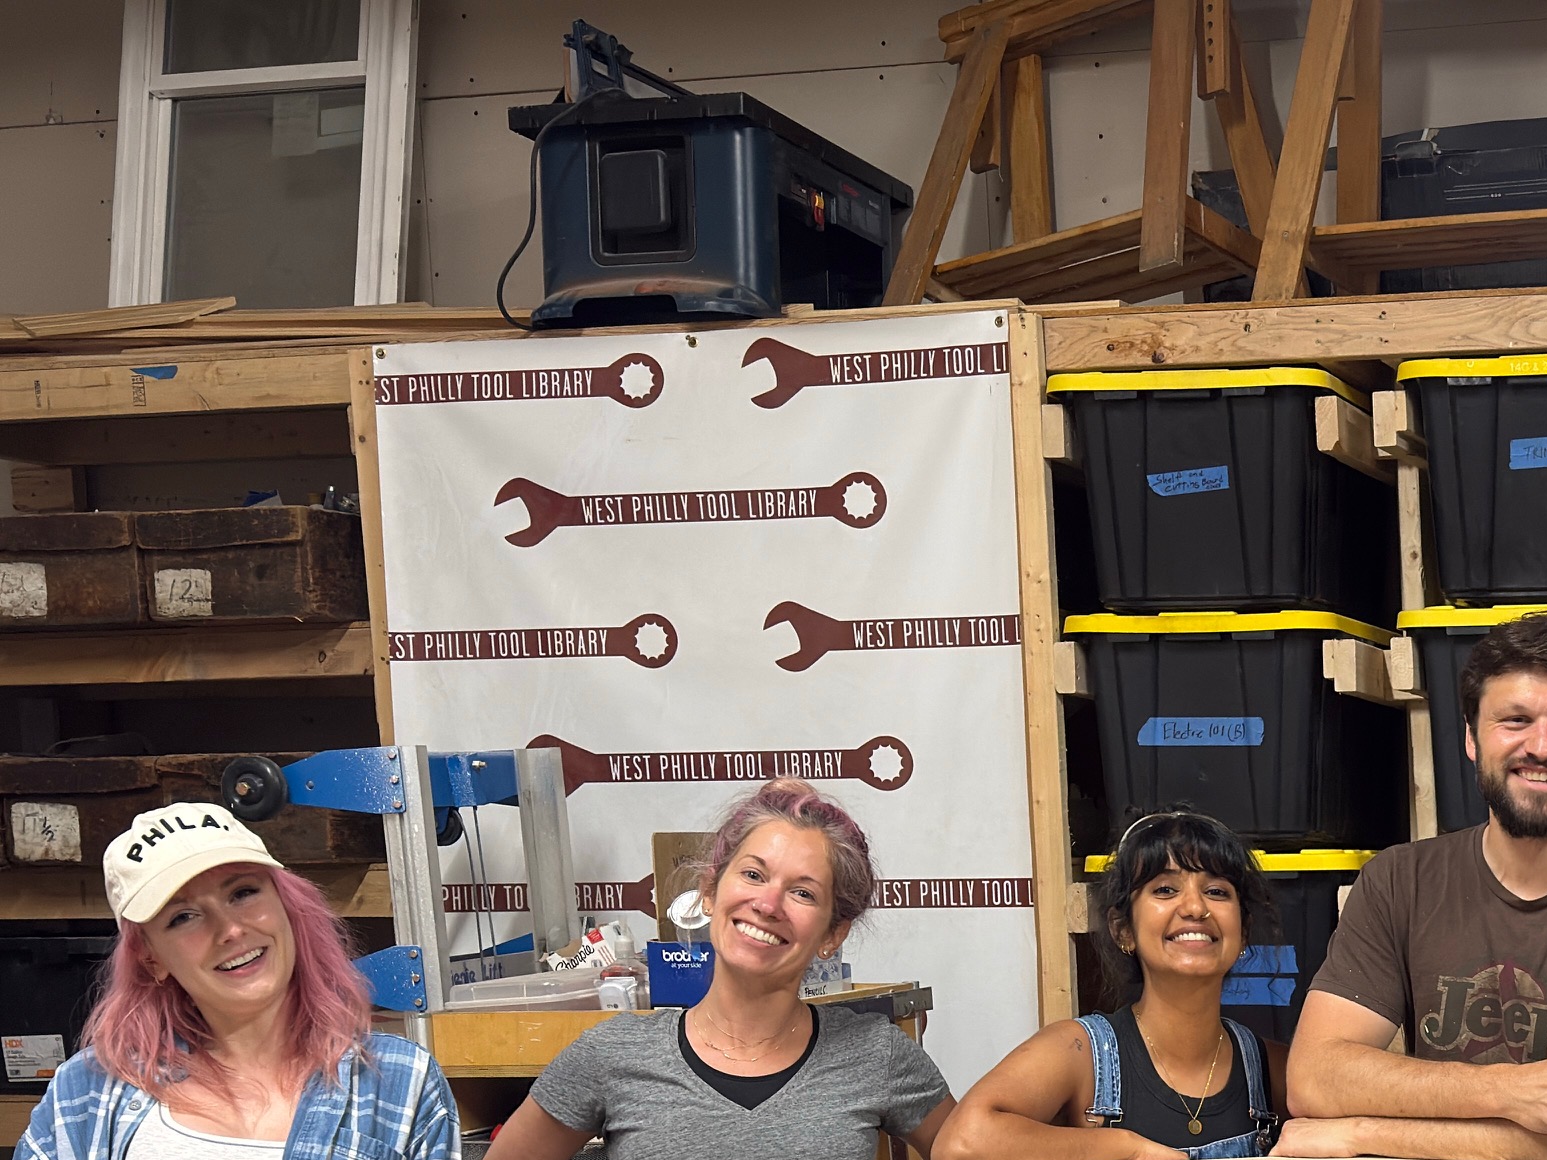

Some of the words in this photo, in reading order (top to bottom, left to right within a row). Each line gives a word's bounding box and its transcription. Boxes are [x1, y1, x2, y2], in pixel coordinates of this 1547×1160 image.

[829, 354, 871, 383] WEST
[880, 350, 935, 380] PHILLY
[943, 346, 985, 375] TOOL
[408, 375, 463, 402] PHILLY
[471, 373, 513, 399] TOOL
[522, 369, 592, 397] LIBRARY
[581, 496, 623, 524] WEST
[632, 494, 688, 522] PHILLY
[696, 492, 740, 520] TOOL
[747, 489, 817, 518] LIBRARY
[424, 632, 480, 658] PHILLY
[489, 631, 530, 657] TOOL
[537, 629, 608, 656] LIBRARY
[853, 621, 894, 648] WEST
[903, 619, 961, 646] PHILLY
[968, 617, 1009, 645] TOOL
[609, 755, 650, 780] WEST
[659, 753, 716, 779] PHILLY
[724, 753, 766, 779] TOOL
[774, 751, 843, 778] LIBRARY
[127, 814, 229, 862] PHILA.
[919, 880, 974, 906] PHILLY
[982, 880, 1022, 906] TOOL
